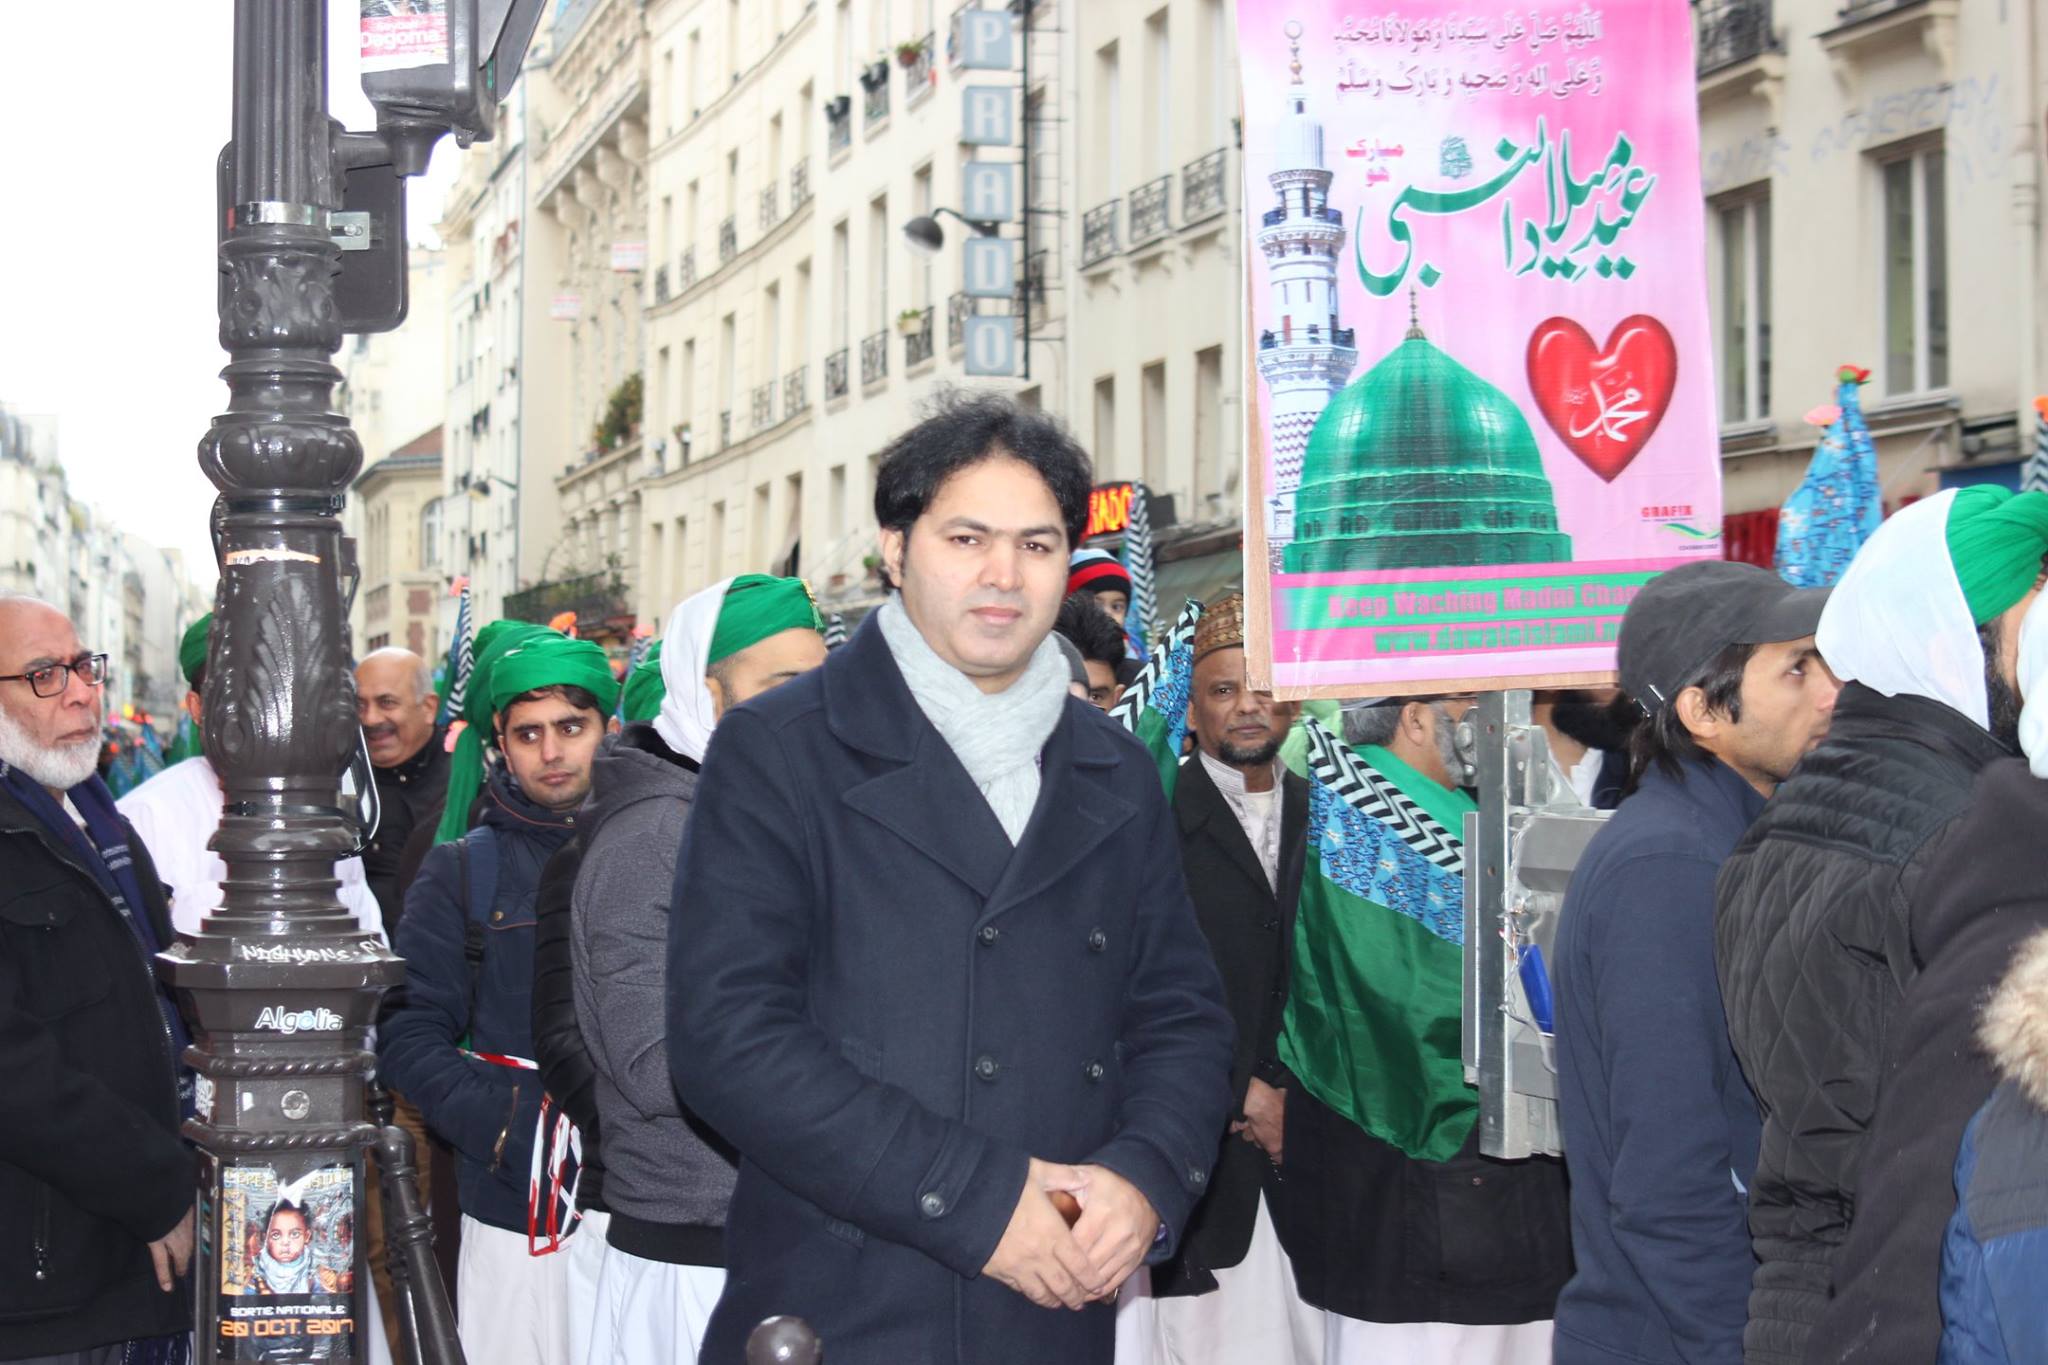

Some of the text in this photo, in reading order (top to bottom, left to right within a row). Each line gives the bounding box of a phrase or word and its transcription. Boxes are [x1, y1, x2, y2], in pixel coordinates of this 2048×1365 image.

[972, 14, 1006, 371] PRADO
[1328, 594, 1389, 620] Keep
[1393, 588, 1497, 616] Waching
[1503, 584, 1575, 611] Madni
[254, 1005, 345, 1034] Algolia
[230, 1304, 347, 1318] SORTIE NATIONALE
[221, 1320, 249, 1337] 20
[306, 1318, 354, 1336] 2017
